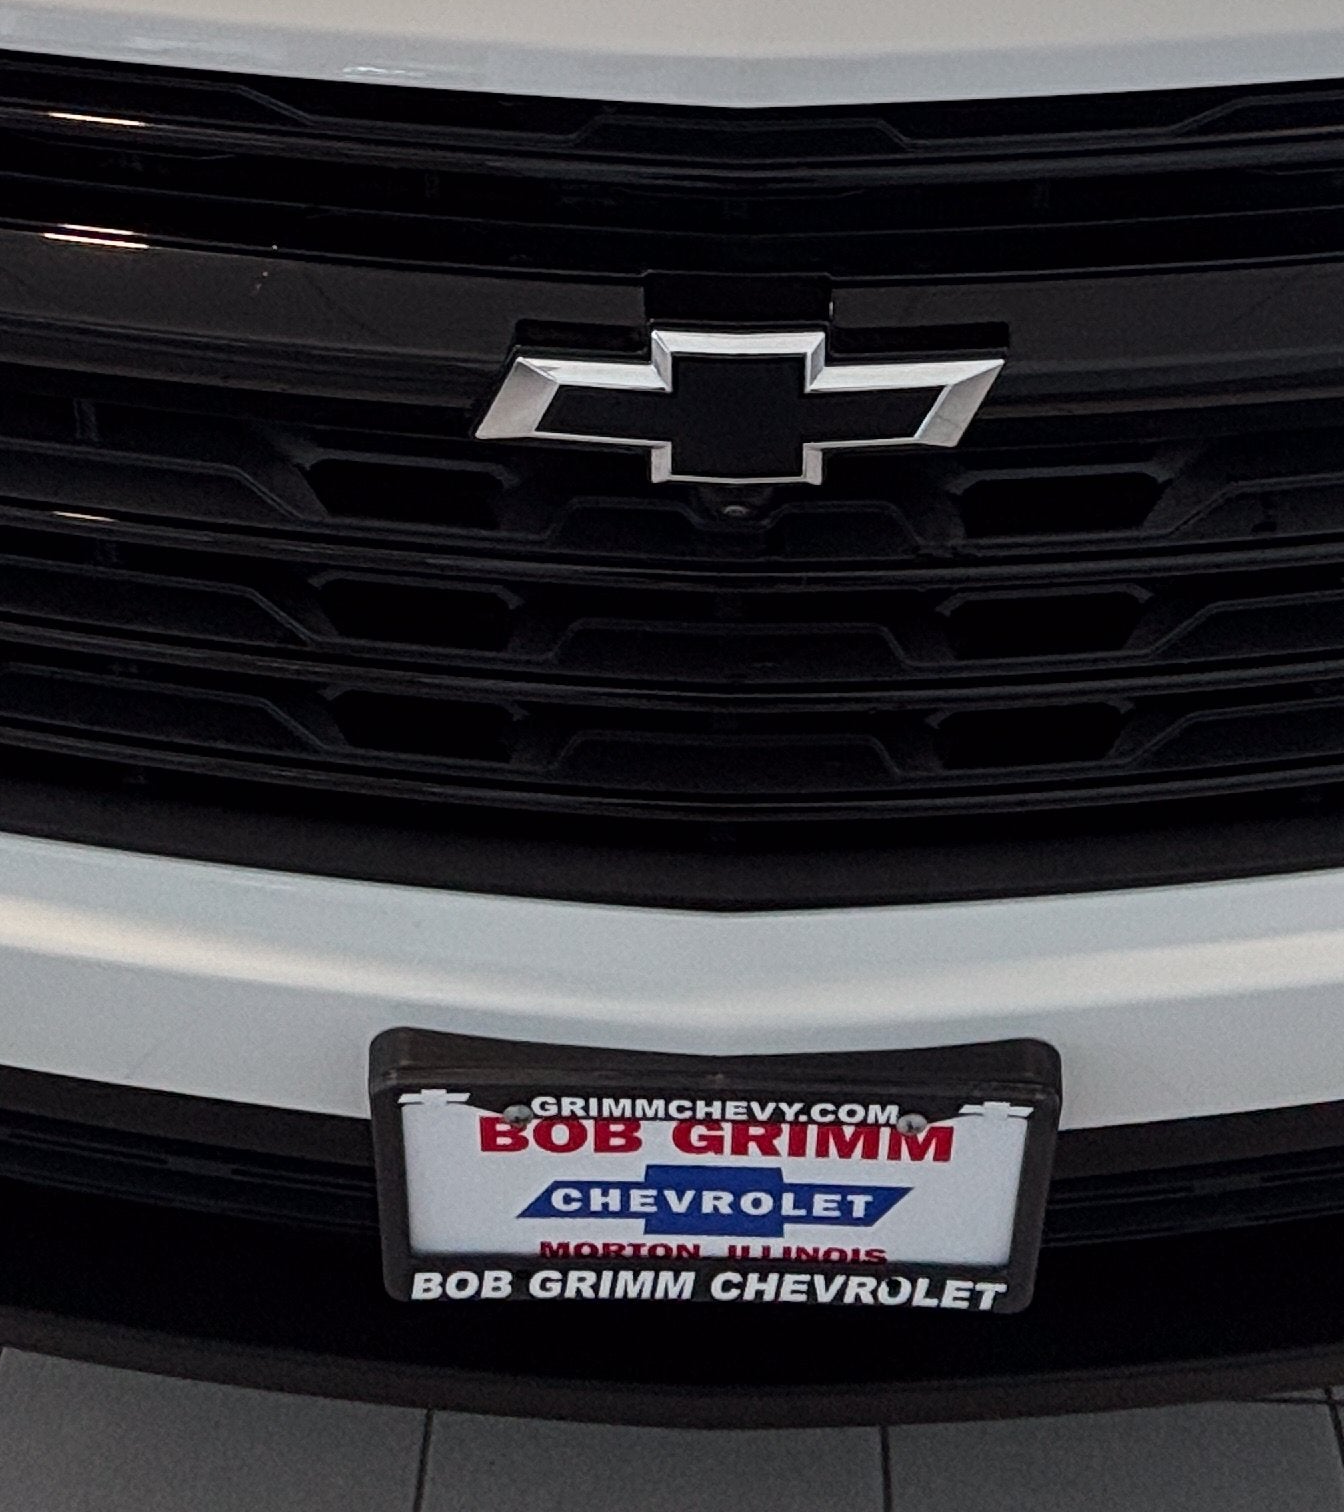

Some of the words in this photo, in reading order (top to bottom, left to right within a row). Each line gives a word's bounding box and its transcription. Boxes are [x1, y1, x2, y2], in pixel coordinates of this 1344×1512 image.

[531, 1096, 900, 1124] GRIMMCHEVY.COM
[479, 1116, 643, 1153] BOB
[672, 1122, 955, 1162] GRIMM
[550, 1188, 874, 1219] CHEVROLET
[539, 1241, 701, 1260] MORTON
[727, 1244, 888, 1265] ILLINOIS
[411, 1270, 514, 1300] BOB
[529, 1270, 696, 1300] GRIMM
[710, 1271, 1007, 1311] CHEVROLET
